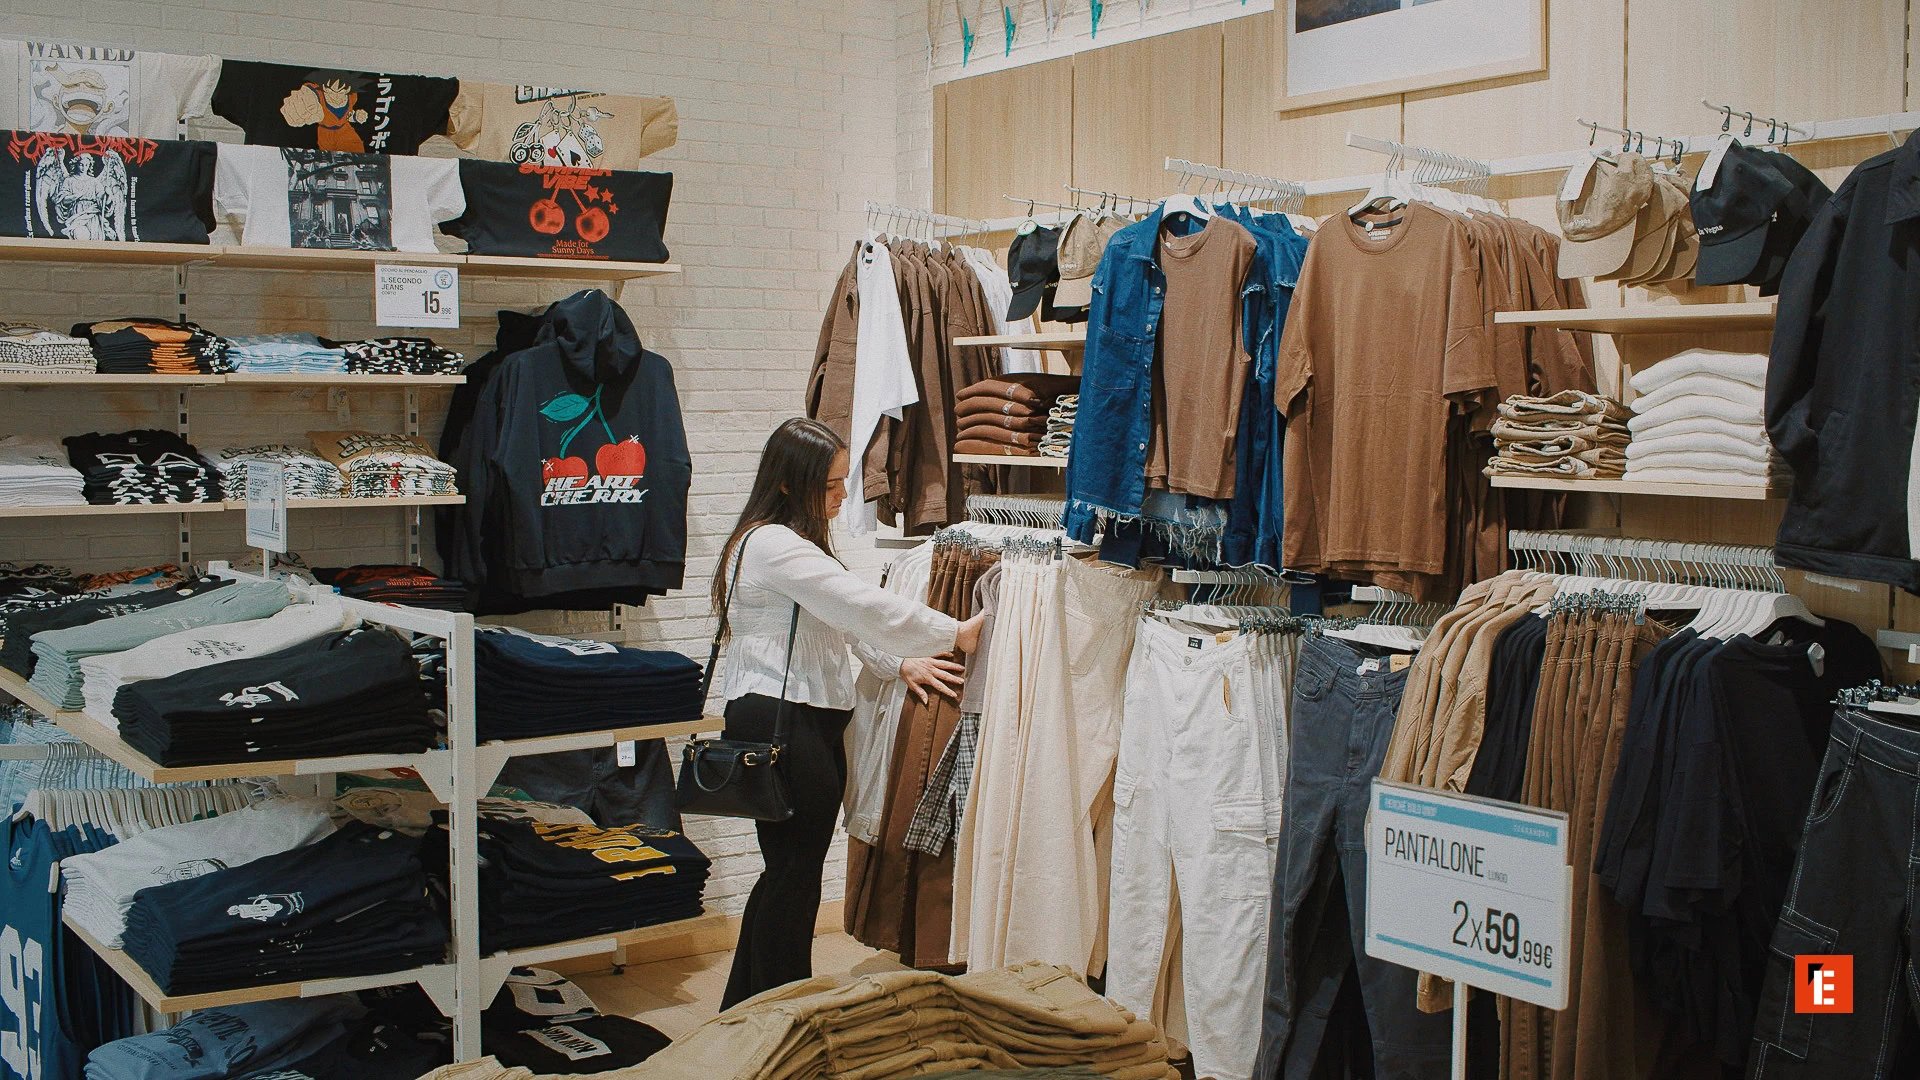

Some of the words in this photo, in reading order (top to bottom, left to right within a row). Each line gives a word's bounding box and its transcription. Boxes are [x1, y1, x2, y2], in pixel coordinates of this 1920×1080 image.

[543, 174, 591, 190] VIBE
[552, 246, 575, 255] Sunny
[576, 247, 594, 256] Days
[556, 239, 577, 247] Made
[578, 240, 588, 249] for
[388, 277, 422, 285] SECONDO
[545, 475, 643, 491] HEART
[541, 489, 649, 506] CHERRY
[1385, 827, 1486, 878] PANTALONE
